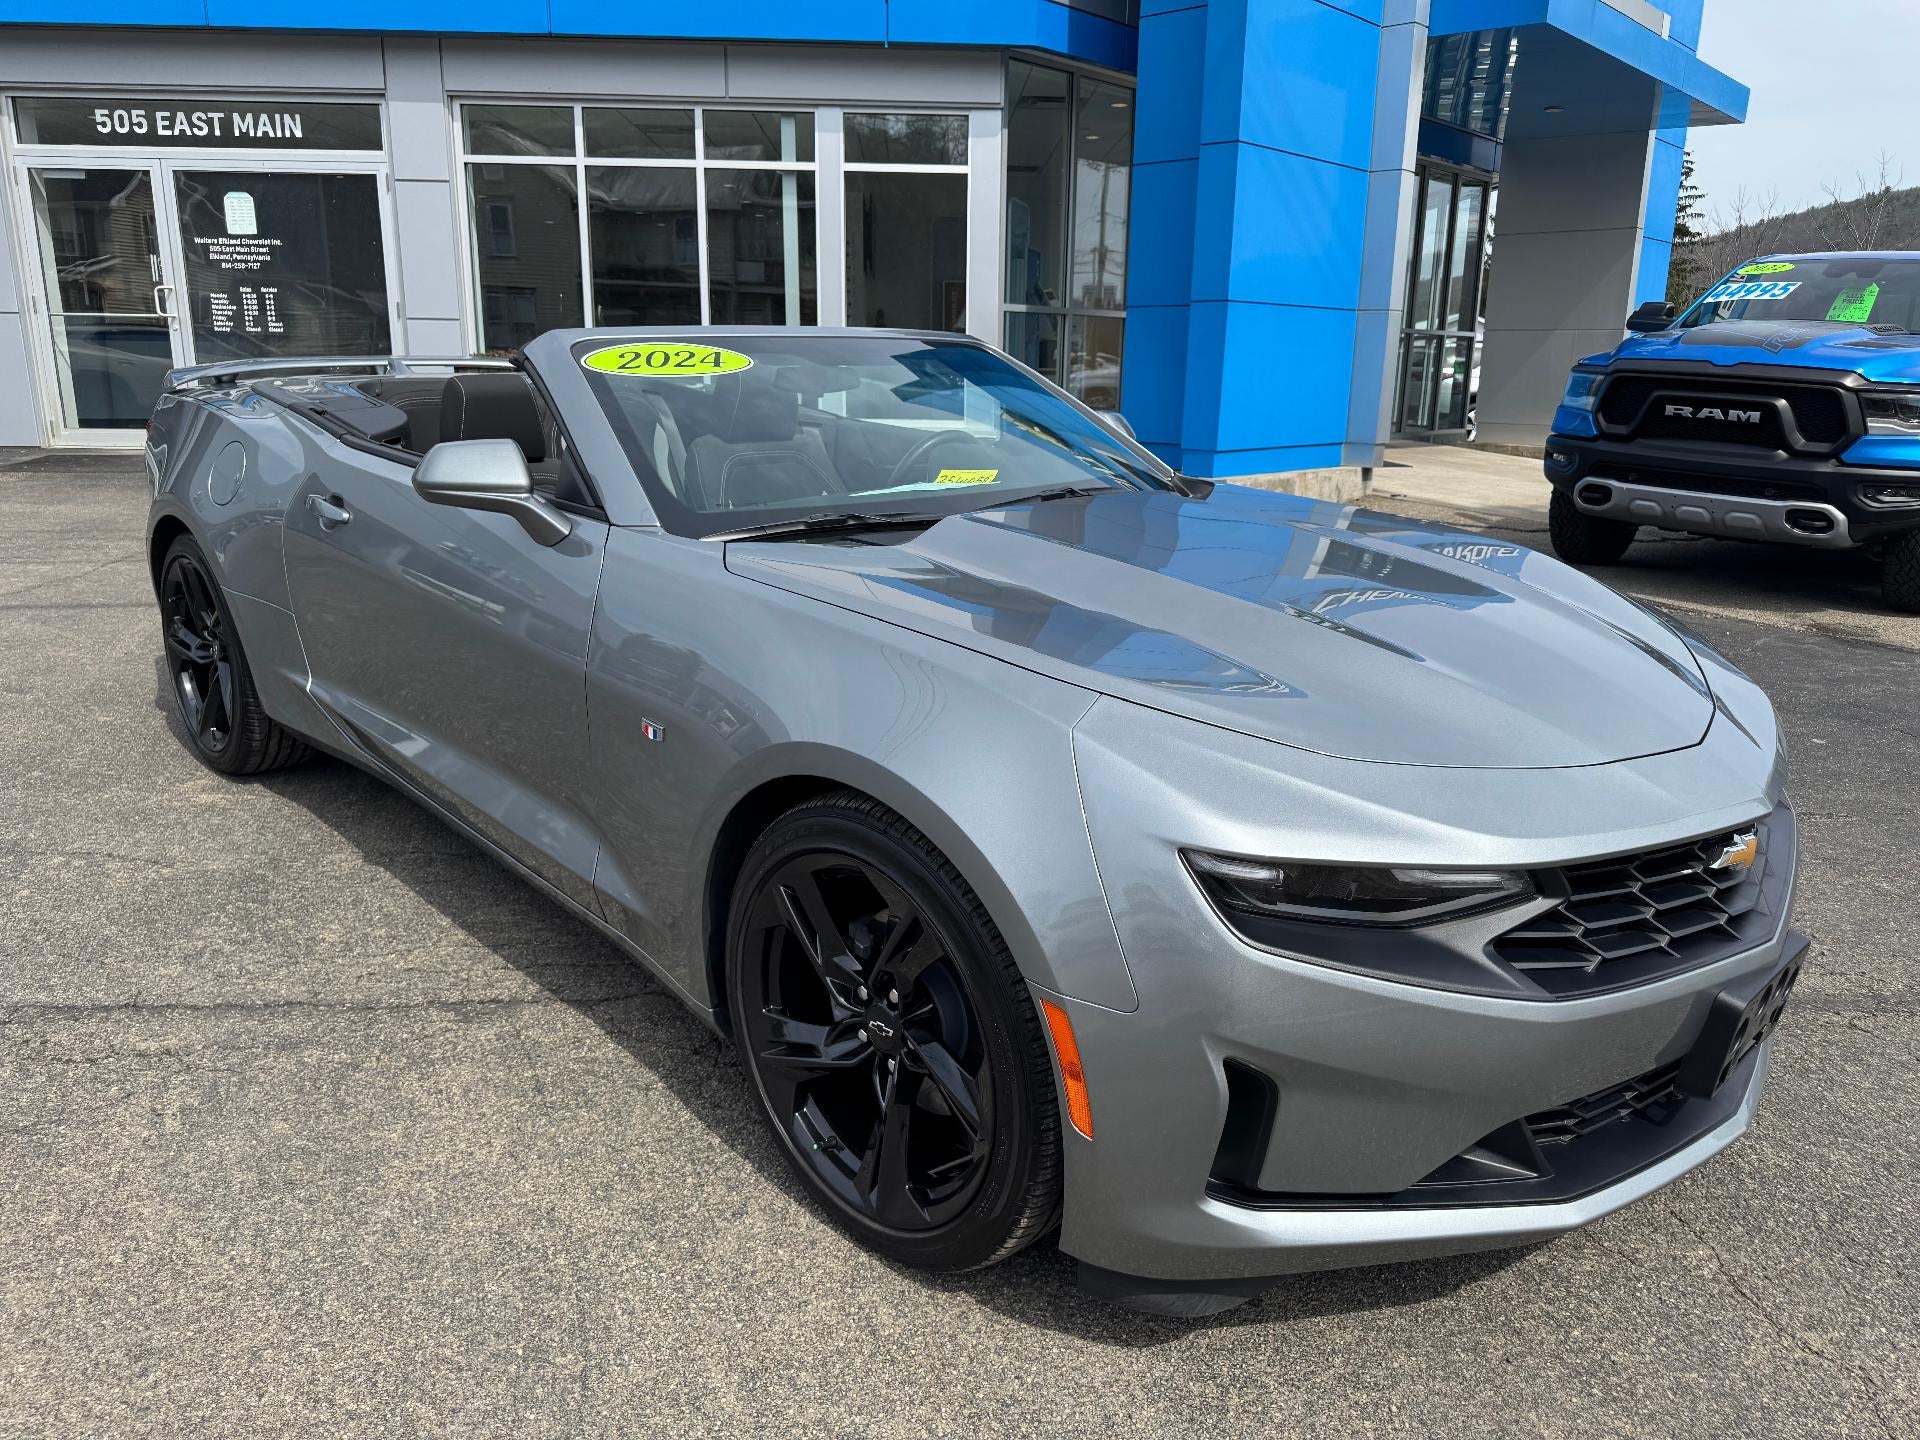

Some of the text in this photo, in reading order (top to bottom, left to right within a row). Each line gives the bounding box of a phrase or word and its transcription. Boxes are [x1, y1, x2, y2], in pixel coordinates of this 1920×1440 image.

[95, 109, 303, 138] 505 EAST MAIN
[617, 350, 727, 370] 2024
[1664, 404, 1761, 423] RAM
